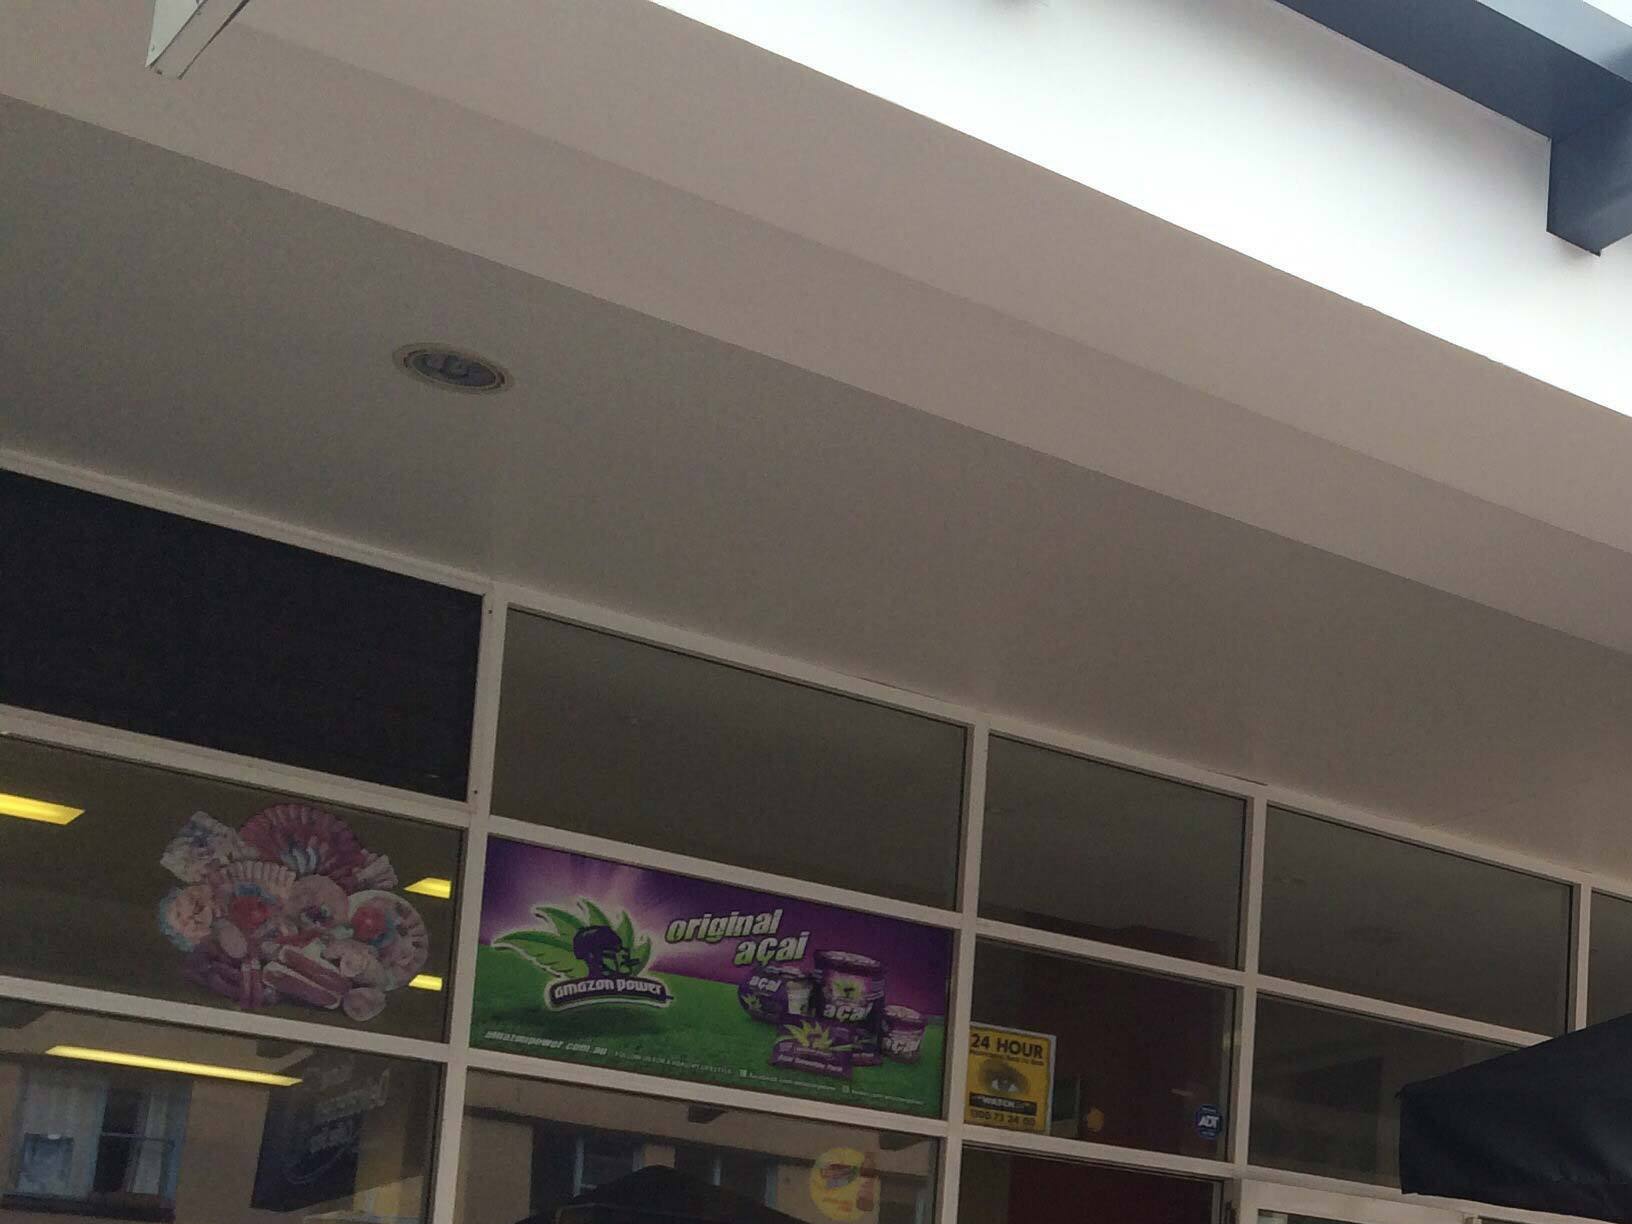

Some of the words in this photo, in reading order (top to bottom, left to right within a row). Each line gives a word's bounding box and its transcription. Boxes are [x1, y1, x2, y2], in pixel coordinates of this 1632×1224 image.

[665, 909, 783, 943] original
[733, 931, 810, 967] açai
[555, 981, 615, 1000] amazon
[616, 979, 662, 997] power
[970, 1033, 990, 1050] 24
[996, 1037, 1044, 1059] HOUR
